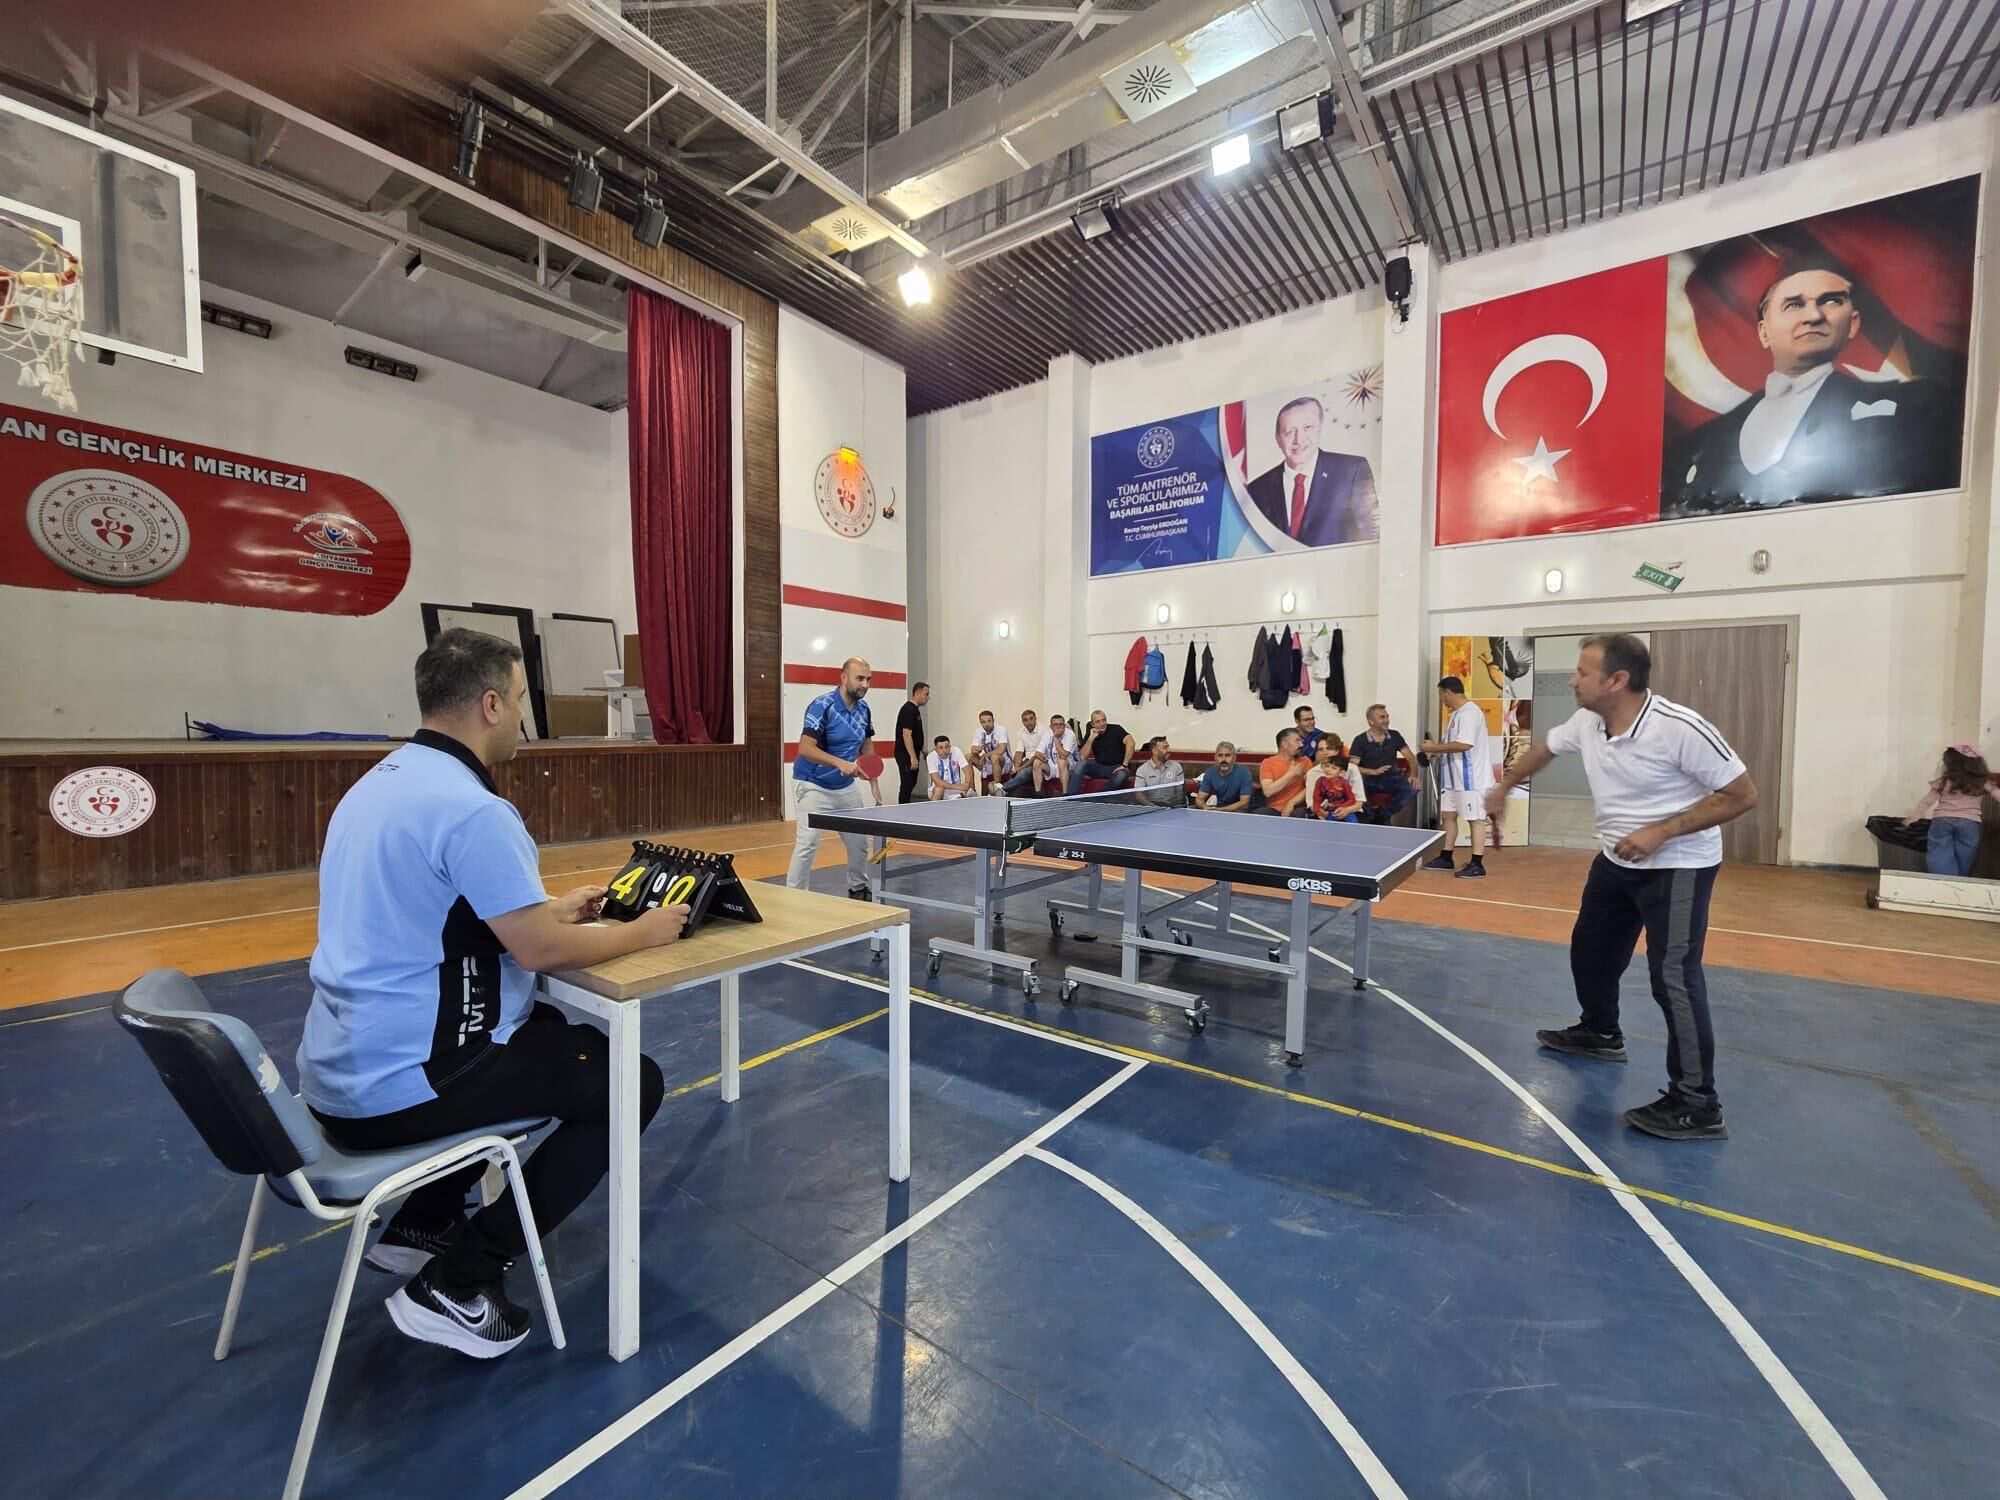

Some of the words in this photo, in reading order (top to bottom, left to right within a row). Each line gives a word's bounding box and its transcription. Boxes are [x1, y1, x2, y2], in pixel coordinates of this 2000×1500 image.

[56, 428, 186, 469] GENÇLİK
[194, 455, 307, 492] MERKEZİ
[1107, 498, 1119, 509] VE
[1120, 482, 1208, 507] SPORCULARIMIZA
[1117, 484, 1139, 496] TÜM
[1141, 472, 1197, 492] ANTRENÖR
[1110, 505, 1155, 519] BAŞARILAR
[1156, 495, 1205, 512] DİLİYORUM
[1642, 569, 1666, 583] EXIT
[610, 866, 646, 900] 4
[652, 872, 668, 893] 0
[1300, 878, 1332, 892] KBS
